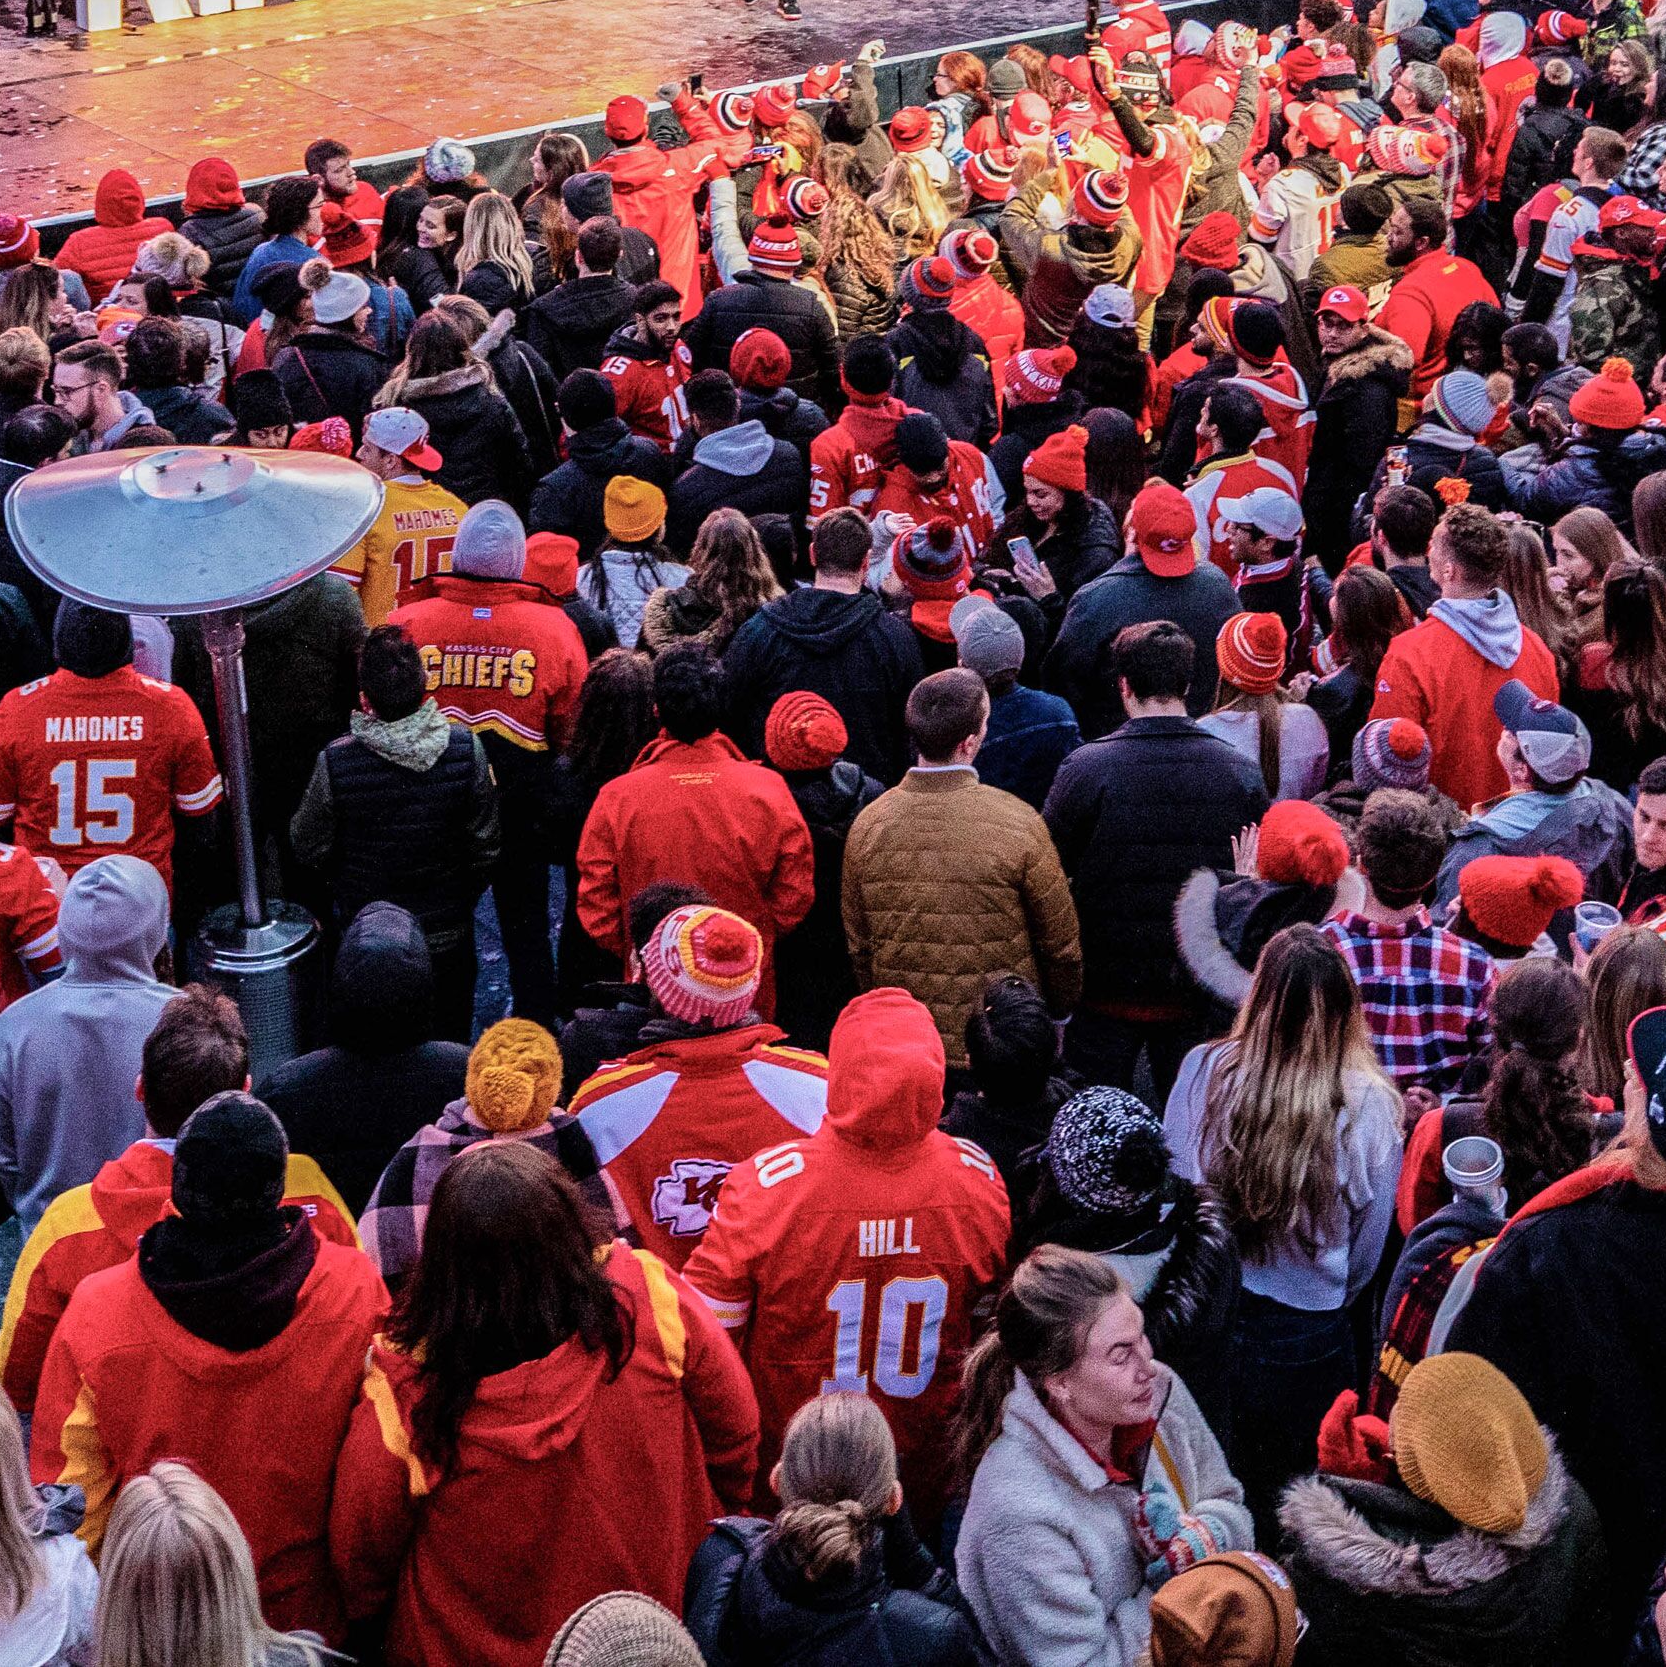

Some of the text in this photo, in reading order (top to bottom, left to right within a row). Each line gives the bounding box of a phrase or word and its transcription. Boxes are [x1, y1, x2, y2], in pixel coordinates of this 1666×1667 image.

[753, 235, 797, 252] CHIEFS
[393, 509, 457, 533] MAHOMES
[445, 643, 513, 655] KANSAS CITY
[419, 645, 536, 696] CHIEFS
[45, 715, 144, 743] MAHOMES
[48, 758, 137, 845] 15
[858, 1218, 920, 1256] HILL
[820, 1275, 949, 1398] 10
